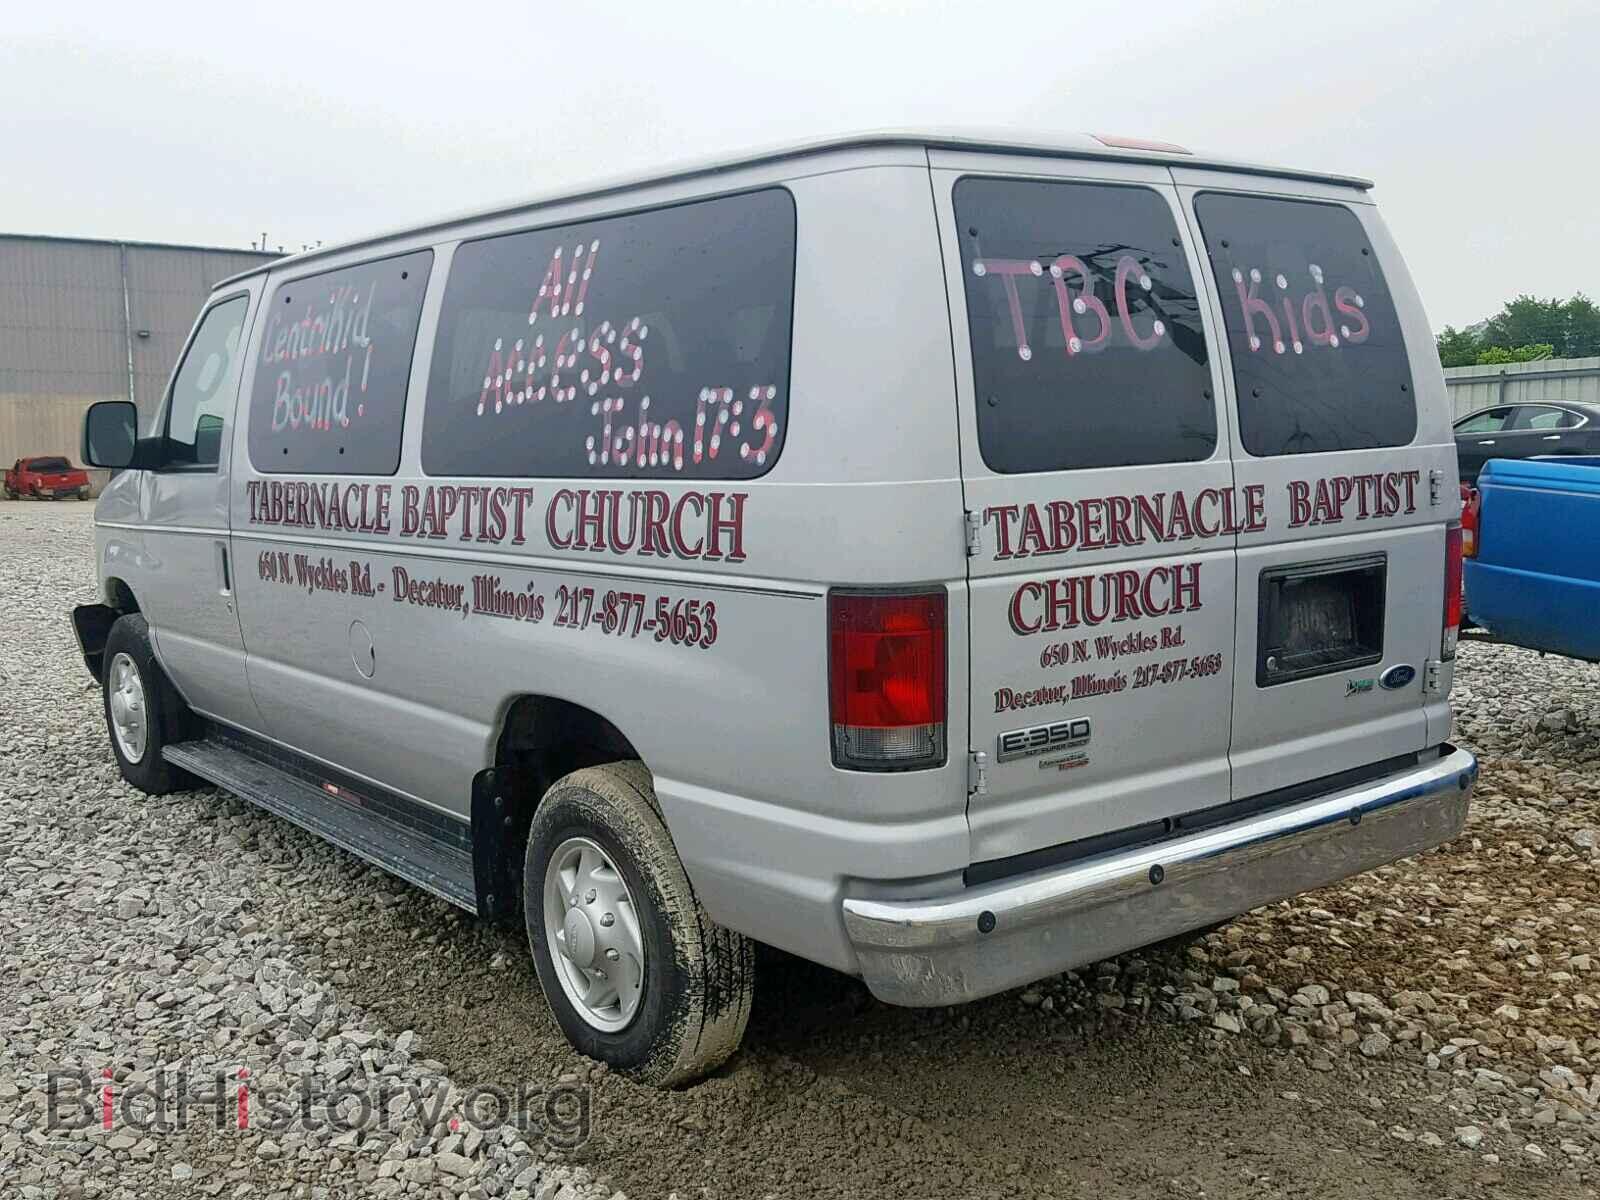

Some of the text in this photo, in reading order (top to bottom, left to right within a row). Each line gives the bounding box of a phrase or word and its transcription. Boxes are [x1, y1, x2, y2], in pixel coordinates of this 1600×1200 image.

[528, 239, 600, 324] All
[973, 255, 1166, 361] TBC
[1231, 263, 1369, 354] Kids
[585, 383, 777, 470] John 17:3
[246, 480, 749, 564] TABERNACLE BAPTIST CHURCH
[983, 469, 1420, 560] TABERNACLE BAPTIST
[293, 554, 349, 594] Wyckles
[392, 566, 470, 619] Decatur,
[471, 574, 545, 624] Illinois
[553, 584, 718, 650] 217-877-5653
[1008, 562, 1203, 636] CHURCH
[993, 652, 1222, 714] Decatur, Illinois 217-877-5653
[1040, 625, 1186, 668] 650 N. Wyckles Rd.
[1002, 719, 1091, 753] E-350
